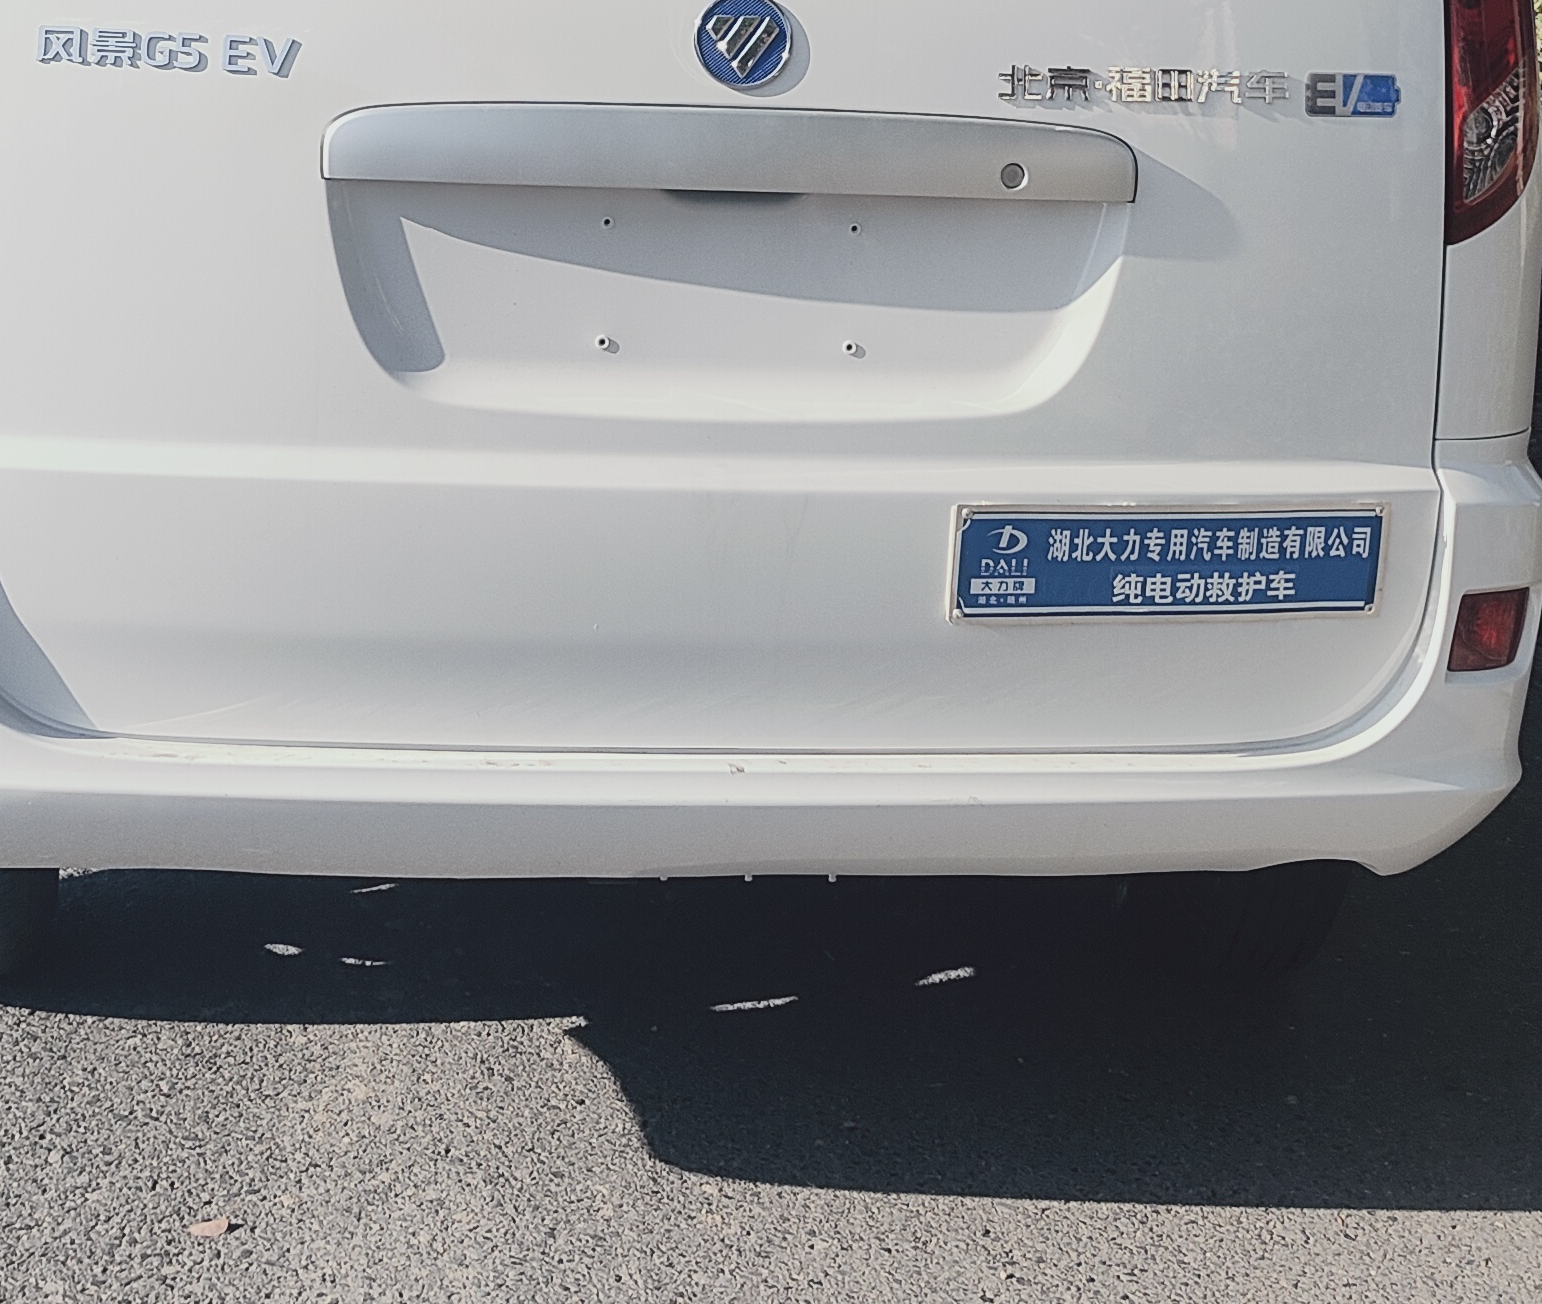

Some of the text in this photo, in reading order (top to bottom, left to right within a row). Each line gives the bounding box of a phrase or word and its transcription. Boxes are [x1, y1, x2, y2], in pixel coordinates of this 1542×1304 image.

[36, 25, 297, 75] 风景G5 EV
[1047, 525, 1372, 562] 湖北大力专用汽车制造有限公司
[980, 558, 1028, 576] DALI
[980, 580, 1025, 592] 大力牌
[1111, 570, 1296, 603] 纯电动救护车
